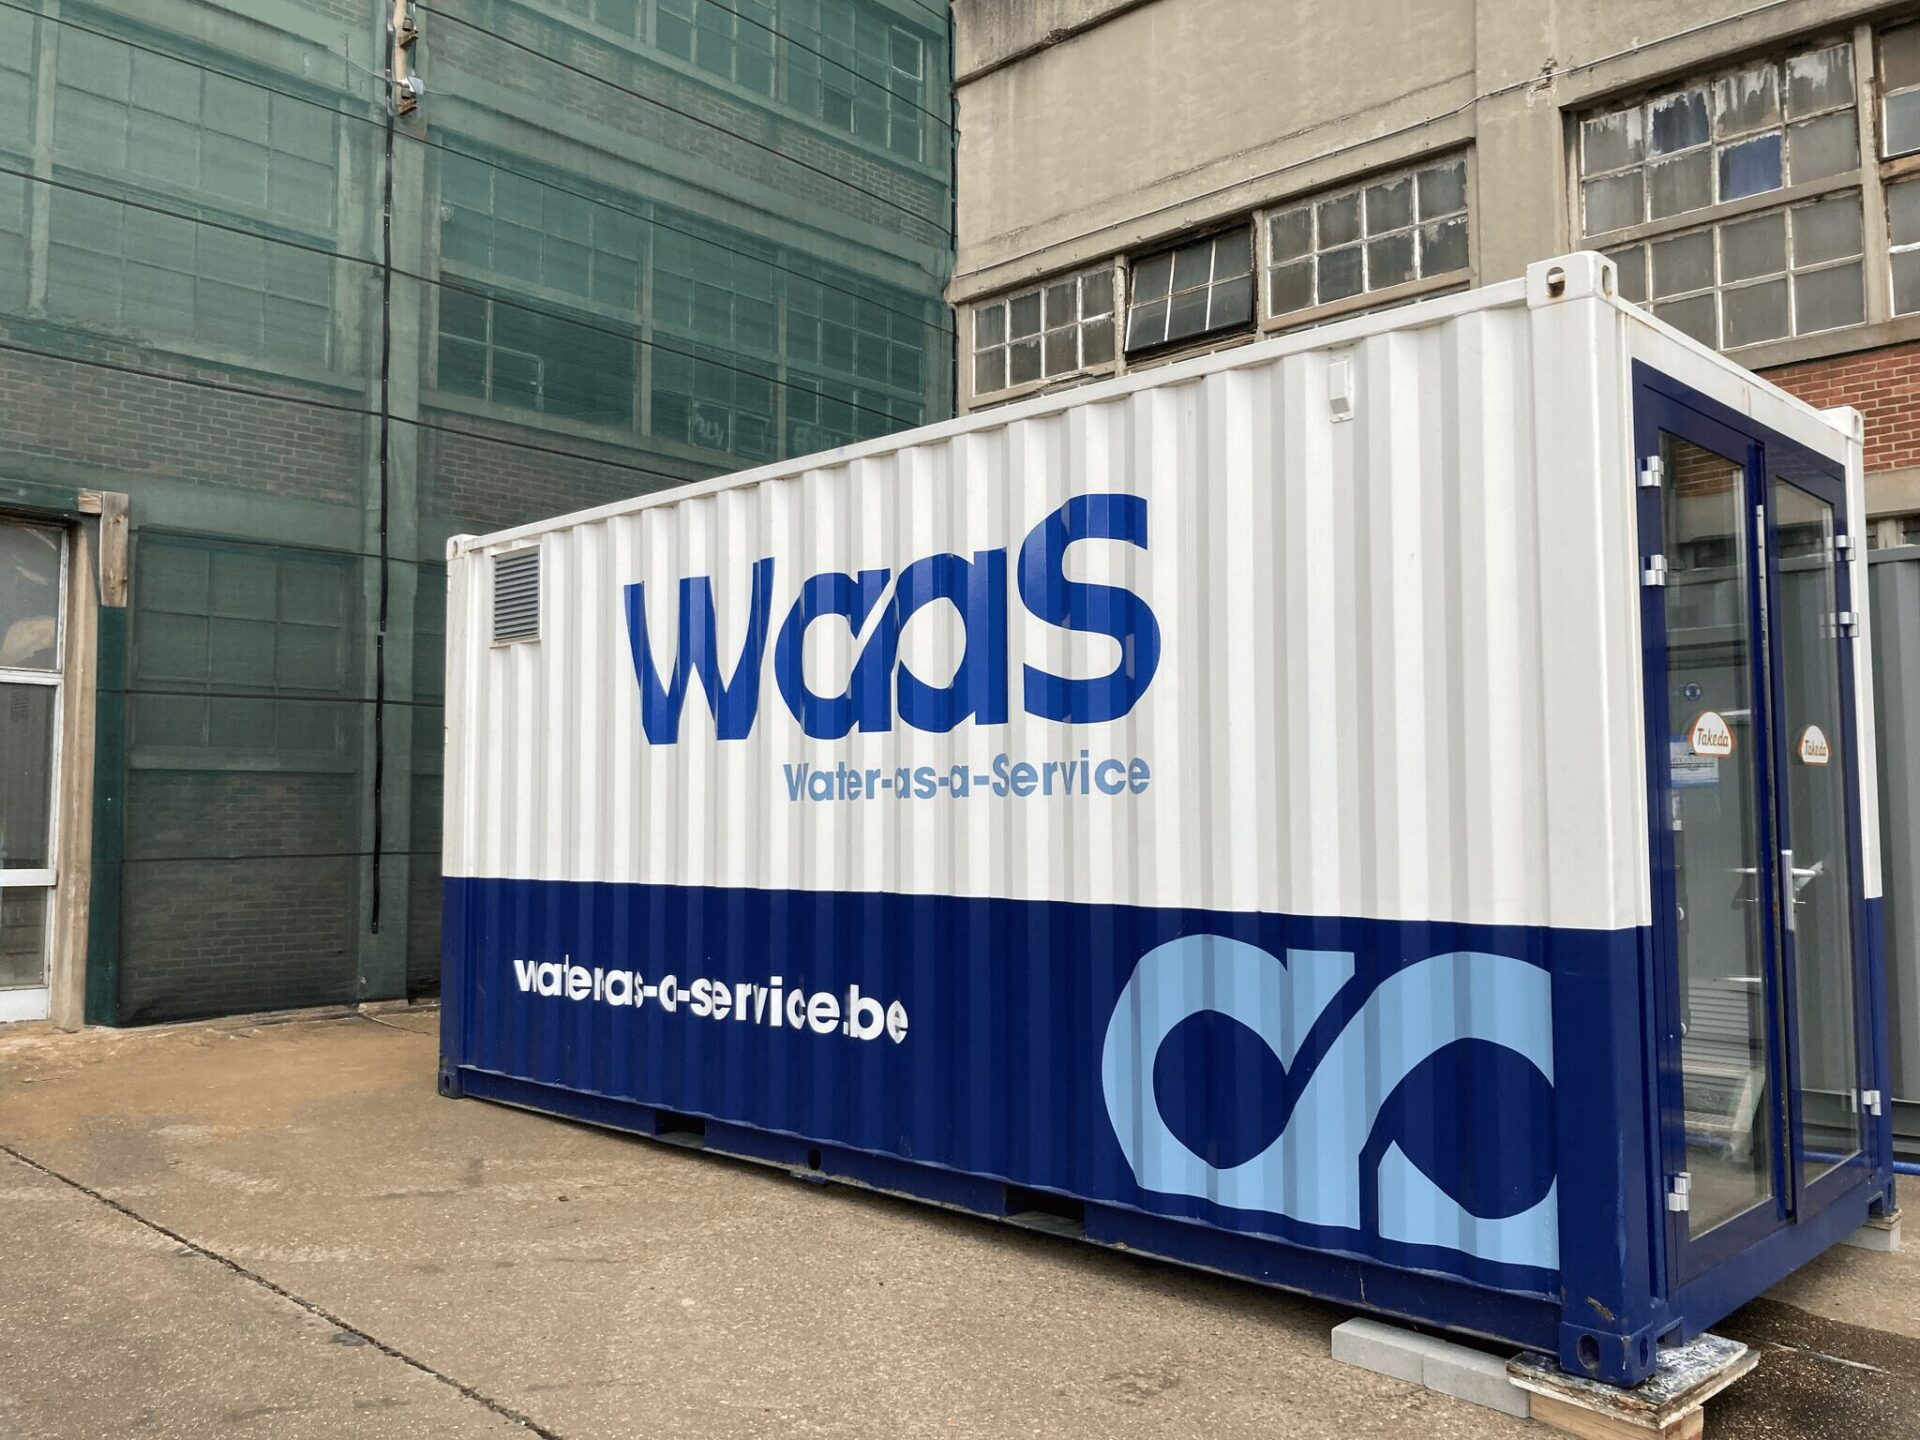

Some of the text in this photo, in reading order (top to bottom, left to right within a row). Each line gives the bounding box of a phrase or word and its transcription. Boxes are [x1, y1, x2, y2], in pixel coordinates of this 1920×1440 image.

[1697, 727, 1729, 748] Takeda
[1804, 740, 1827, 757] Takeda
[783, 749, 1150, 802] Water-as-a-Service
